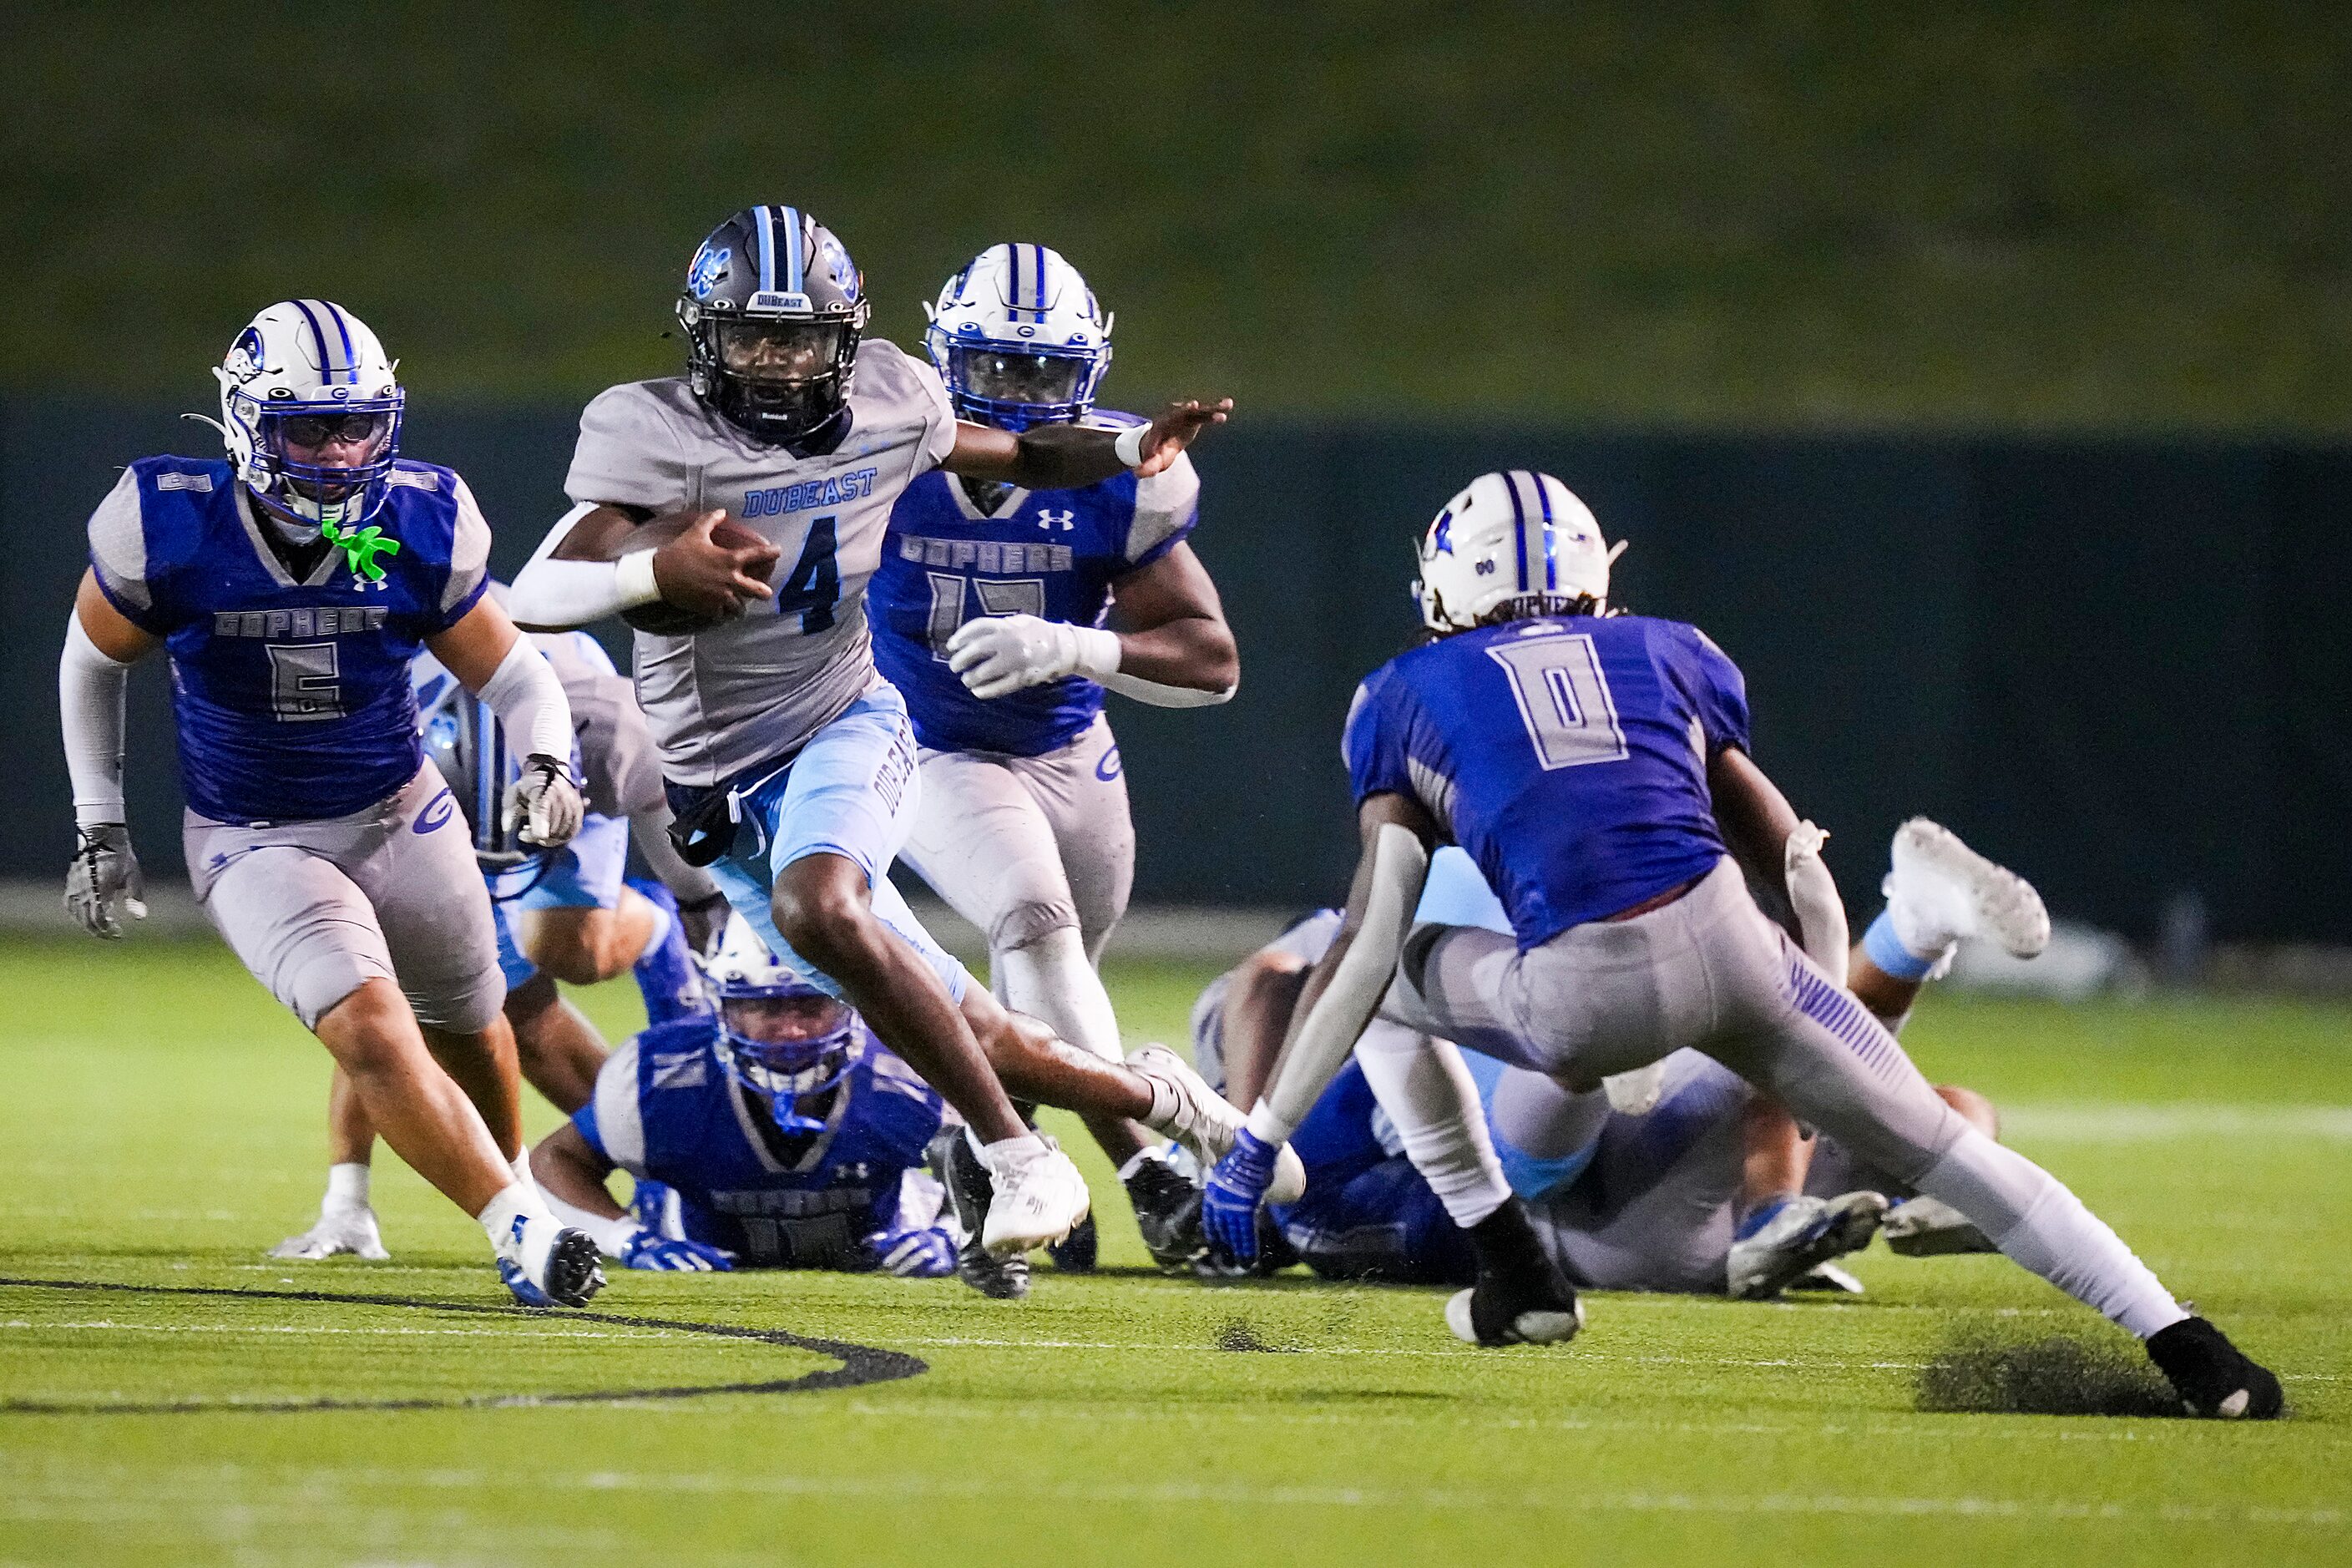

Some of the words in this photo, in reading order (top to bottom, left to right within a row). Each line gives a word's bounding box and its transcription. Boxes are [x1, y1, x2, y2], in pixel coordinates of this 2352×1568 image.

[757, 295, 802, 308] DUBEAST
[742, 468, 878, 518] DUBEAST
[775, 515, 842, 636] 4
[899, 534, 1073, 574] GOPHERS
[214, 606, 389, 637] GOPHERS
[1485, 633, 1630, 771] 0
